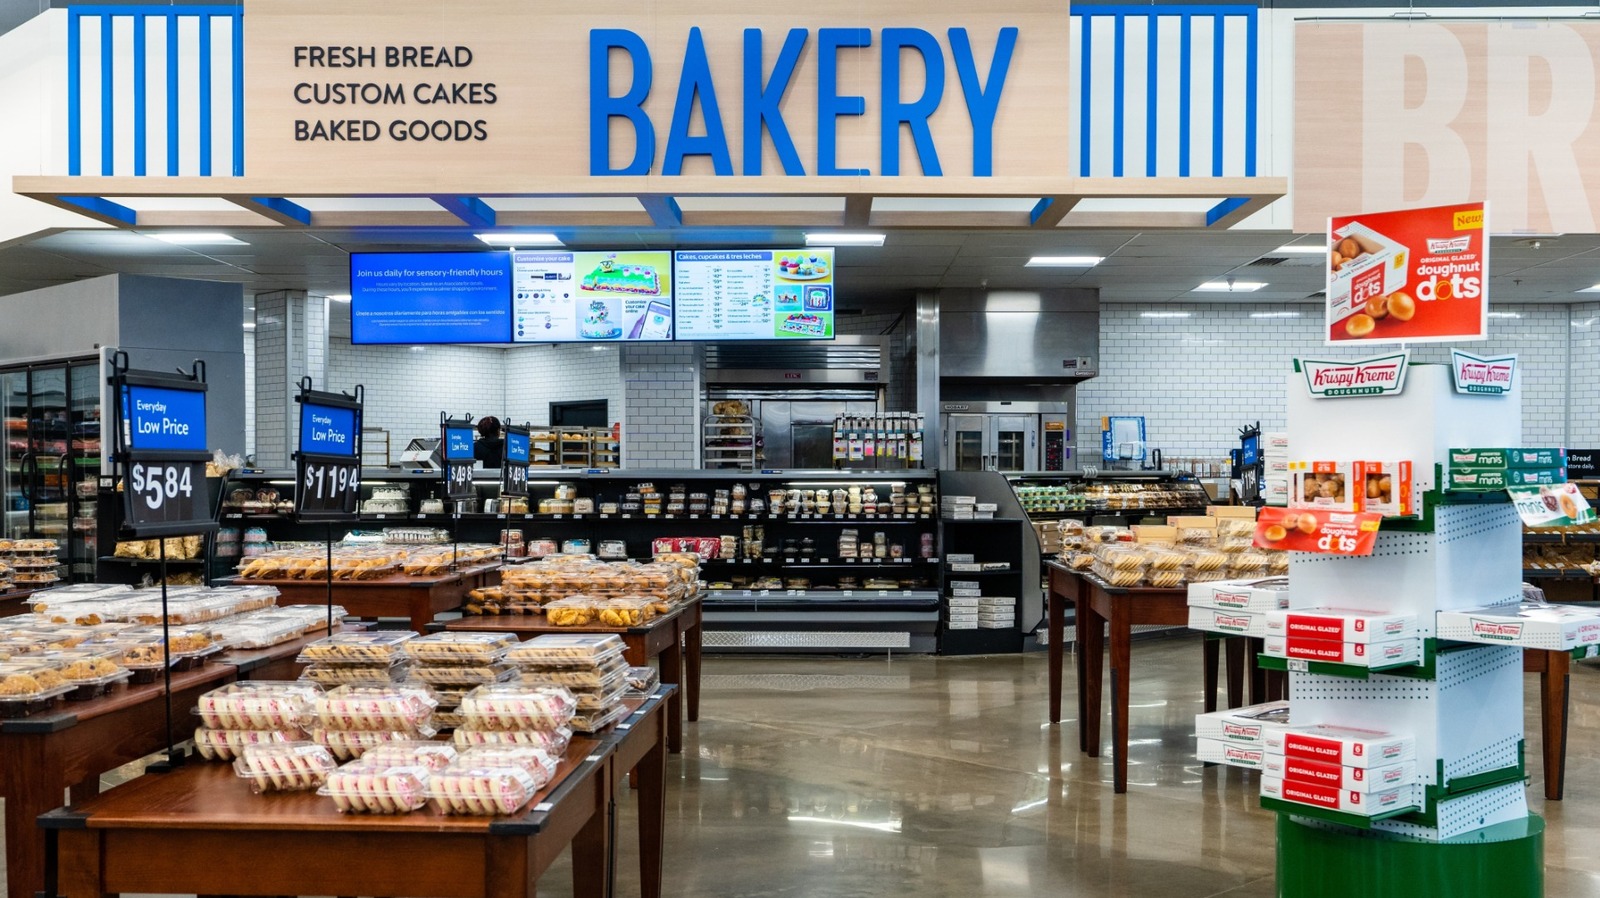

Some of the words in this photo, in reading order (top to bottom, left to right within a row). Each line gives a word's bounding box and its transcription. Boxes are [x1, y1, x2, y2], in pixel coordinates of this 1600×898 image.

[293, 46, 377, 68] FRESH
[385, 46, 473, 68] BREAD
[293, 82, 406, 105] CUSTOM
[413, 82, 498, 105] CAKES
[589, 26, 1019, 176] BAKERY
[293, 119, 382, 142] BAKED
[388, 119, 488, 142] GOODS
[384, 270, 402, 278] daily
[416, 269, 480, 278] sensory-friendly
[480, 268, 504, 276] hours
[1416, 261, 1480, 277] doughnut
[1416, 273, 1480, 301] dots
[1313, 366, 1354, 386] Krispy
[1354, 364, 1398, 384] Kreme
[1460, 363, 1486, 384] Krispy
[1486, 366, 1511, 382] Kreme
[1327, 387, 1381, 395] DOUGHNUTS
[136, 400, 166, 414] Everyday
[138, 416, 160, 434] Low
[162, 418, 189, 435] Price
[312, 414, 332, 426] Everyday
[312, 427, 327, 442] Low
[328, 428, 346, 443] Price
[452, 442, 460, 450] Low
[460, 442, 469, 451] Price
[1478, 456, 1502, 464] minis
[1572, 454, 1592, 462] Bread
[1479, 477, 1503, 485] minis
[1320, 527, 1358, 537] doughnut
[1318, 534, 1358, 552] dots
[1290, 624, 1317, 632] ORIGINAL
[1356, 621, 1362, 629] 6
[1474, 622, 1497, 634] Krispy
[1497, 625, 1520, 635] Kreme
[1290, 647, 1317, 655] ORIGINAL
[1356, 645, 1362, 653] 6
[1288, 743, 1315, 752] ORIGINAL
[1288, 767, 1315, 776] ORIGINAL
[1286, 789, 1312, 799] ORIGINAL
